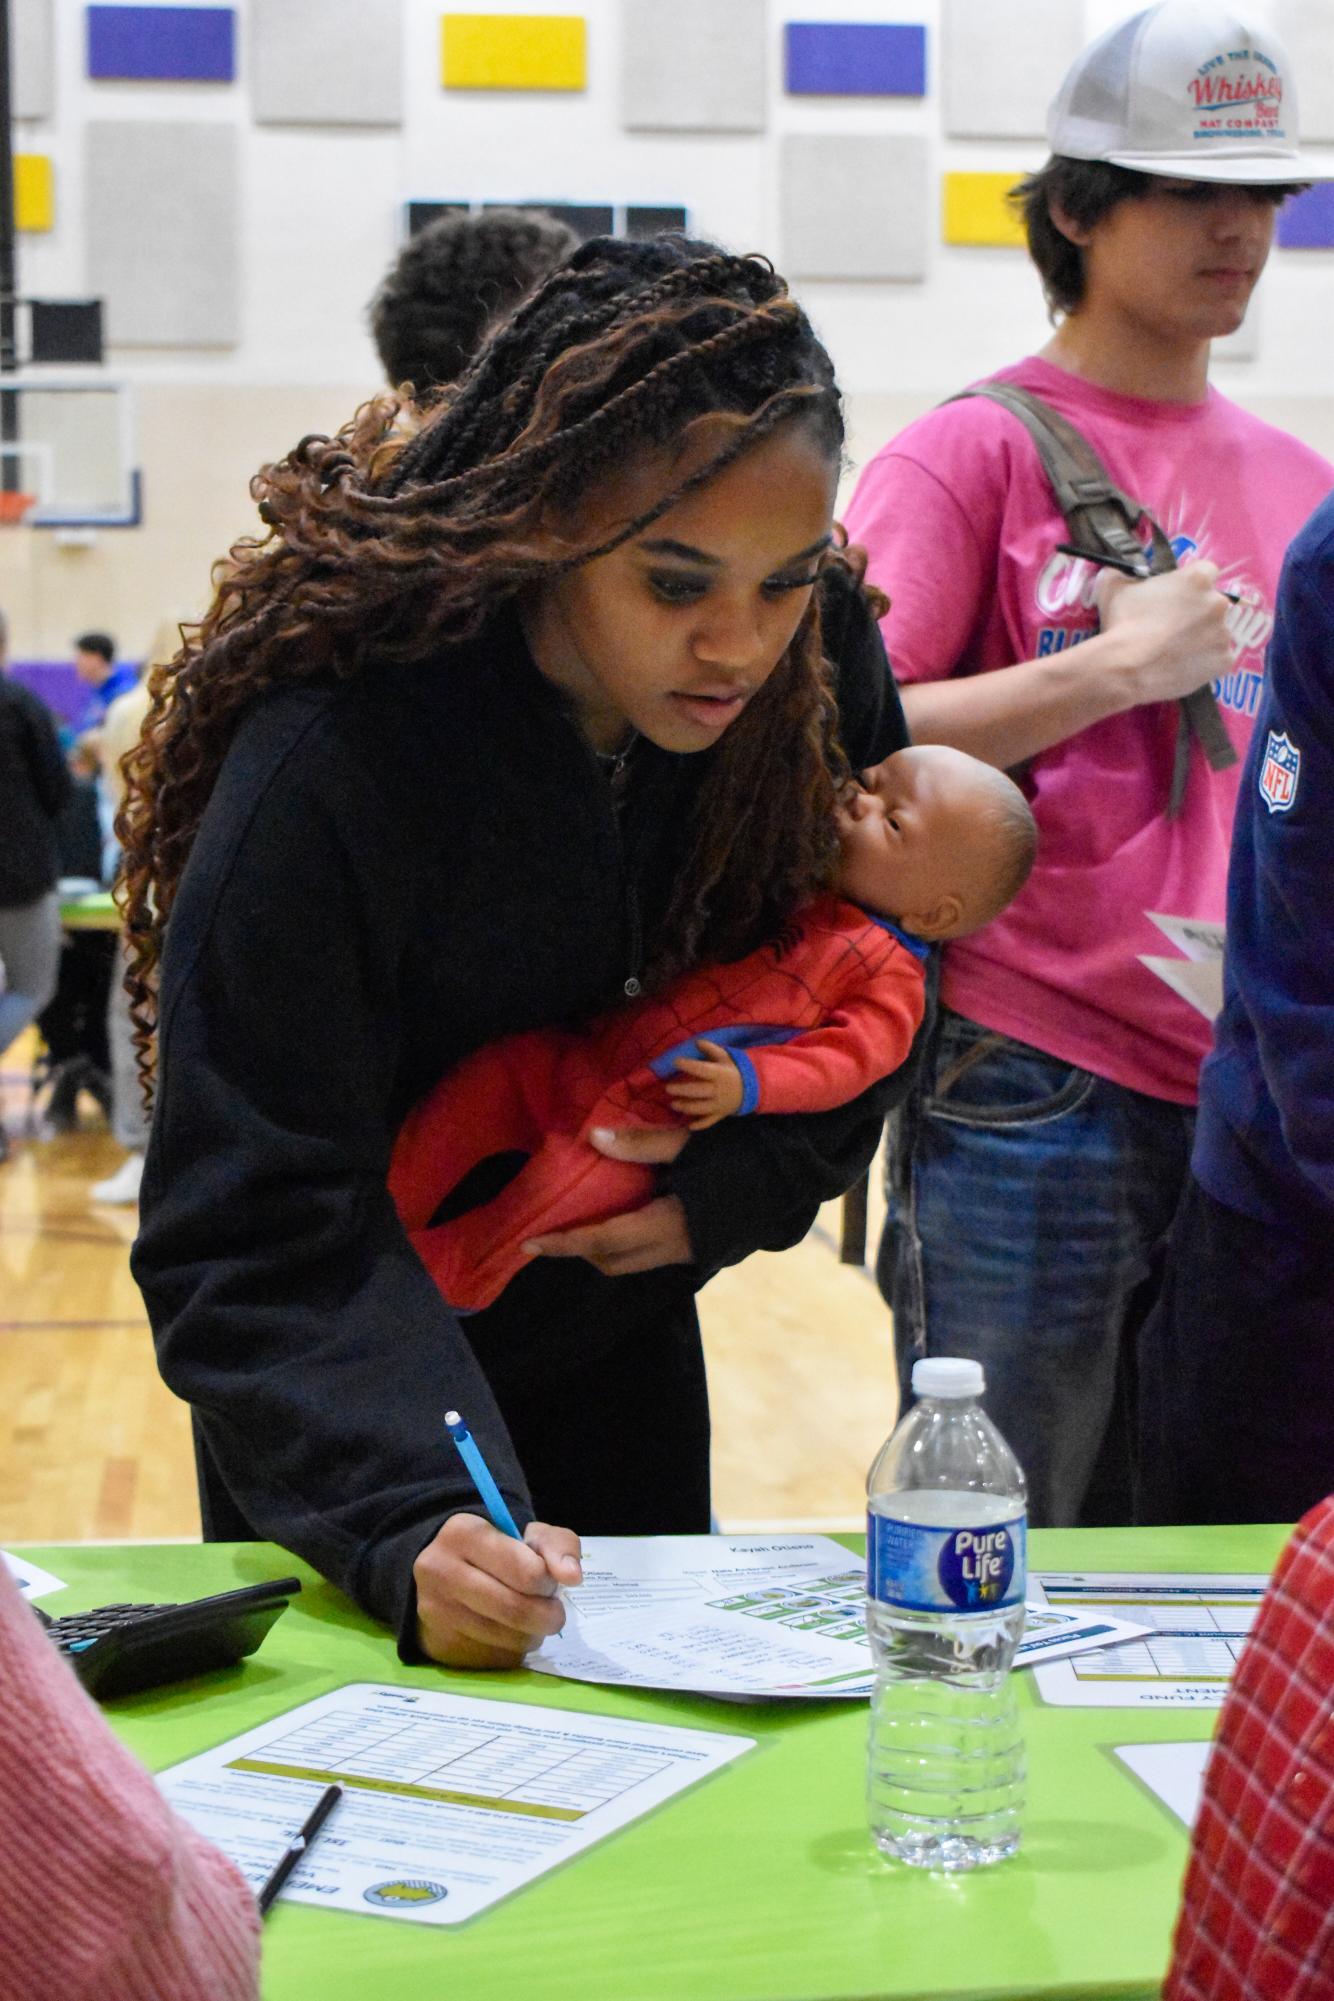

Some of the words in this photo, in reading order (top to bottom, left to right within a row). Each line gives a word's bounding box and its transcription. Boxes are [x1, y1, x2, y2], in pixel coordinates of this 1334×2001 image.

[1197, 55, 1224, 76] LIVE
[1227, 49, 1249, 61] THE
[1199, 119, 1221, 128] HAT
[1227, 119, 1279, 128] COMPANY
[1262, 758, 1291, 802] NFL
[955, 1531, 1007, 1555] Pure
[962, 1553, 1001, 1583] Life
